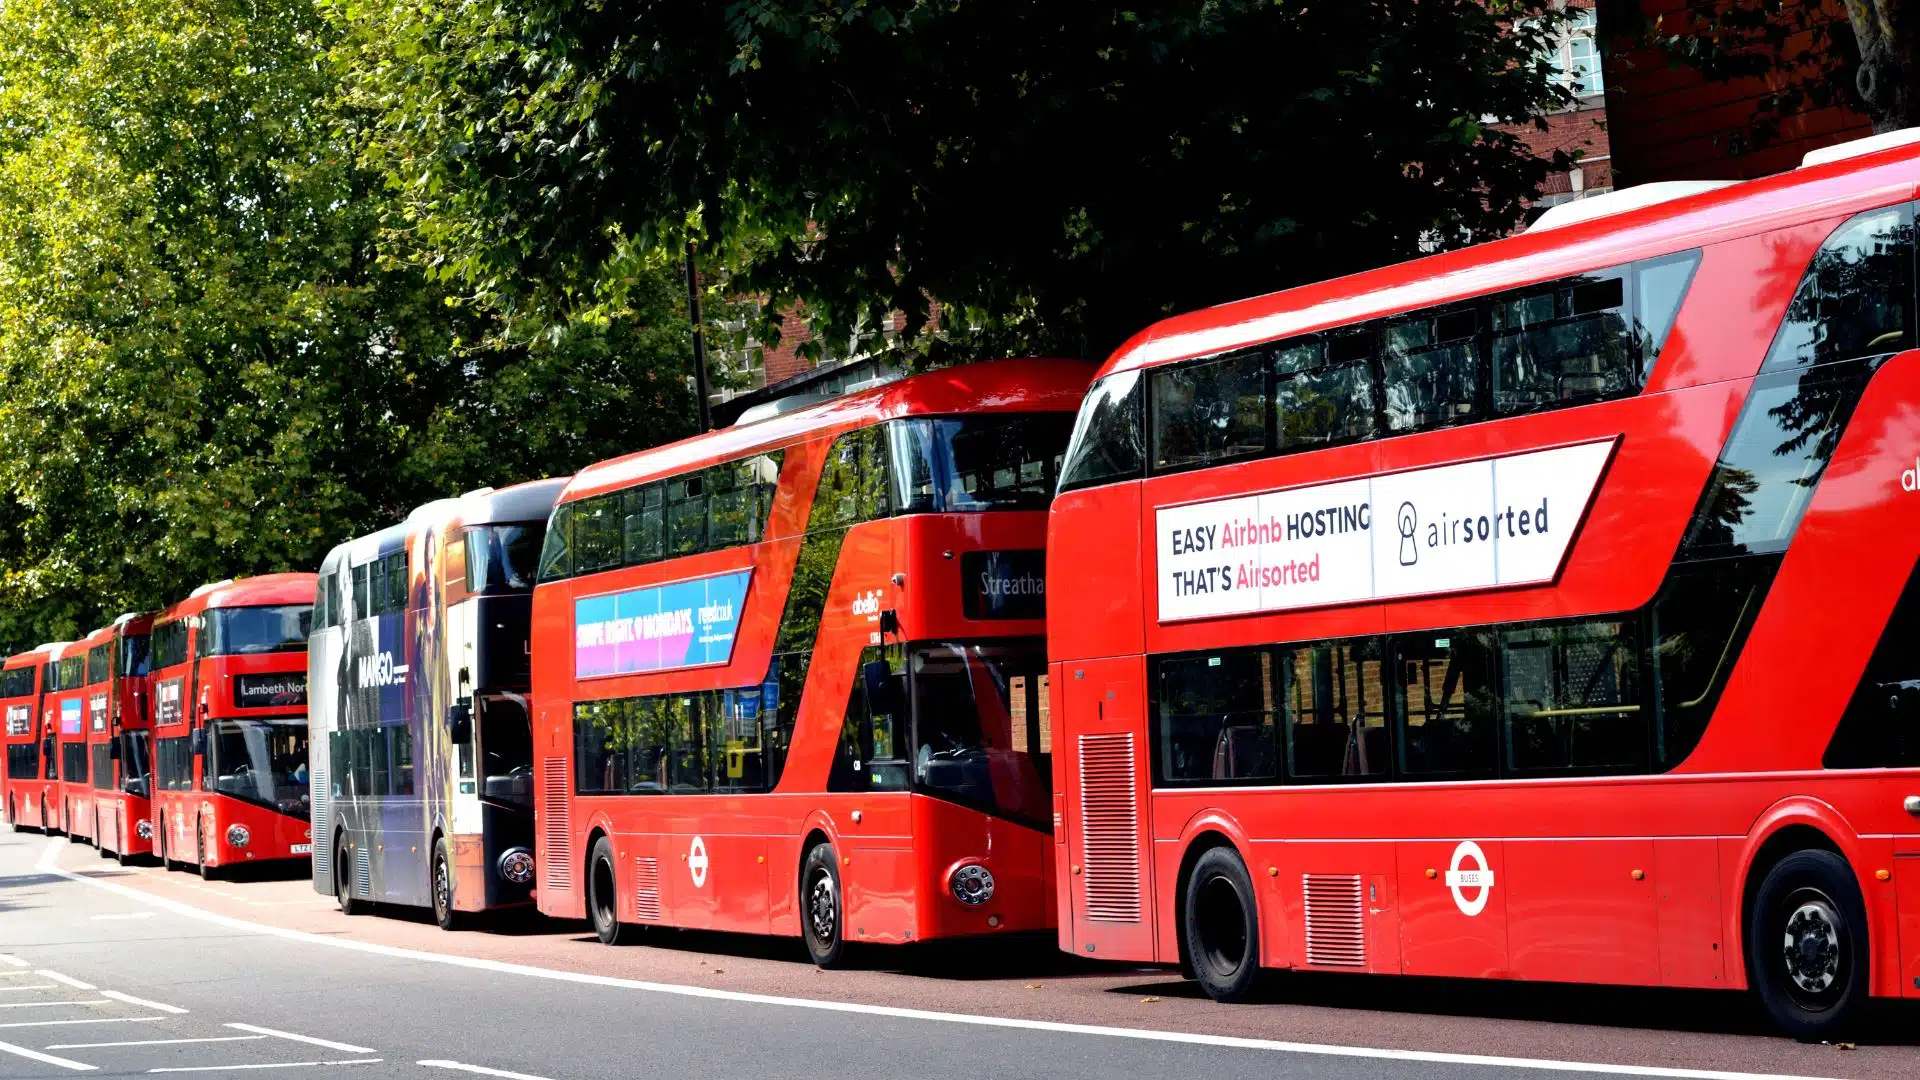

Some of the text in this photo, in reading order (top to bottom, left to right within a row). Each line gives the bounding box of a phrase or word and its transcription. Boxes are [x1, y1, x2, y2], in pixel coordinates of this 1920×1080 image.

[1172, 502, 1371, 556] EASY Airbnb HOSTING
[1427, 497, 1549, 548] airsorted
[1172, 552, 1320, 597] THAT'S Airsorted
[243, 683, 285, 696] Lambeth
[358, 650, 393, 689] MANGO
[1460, 873, 1480, 884] BUSES
